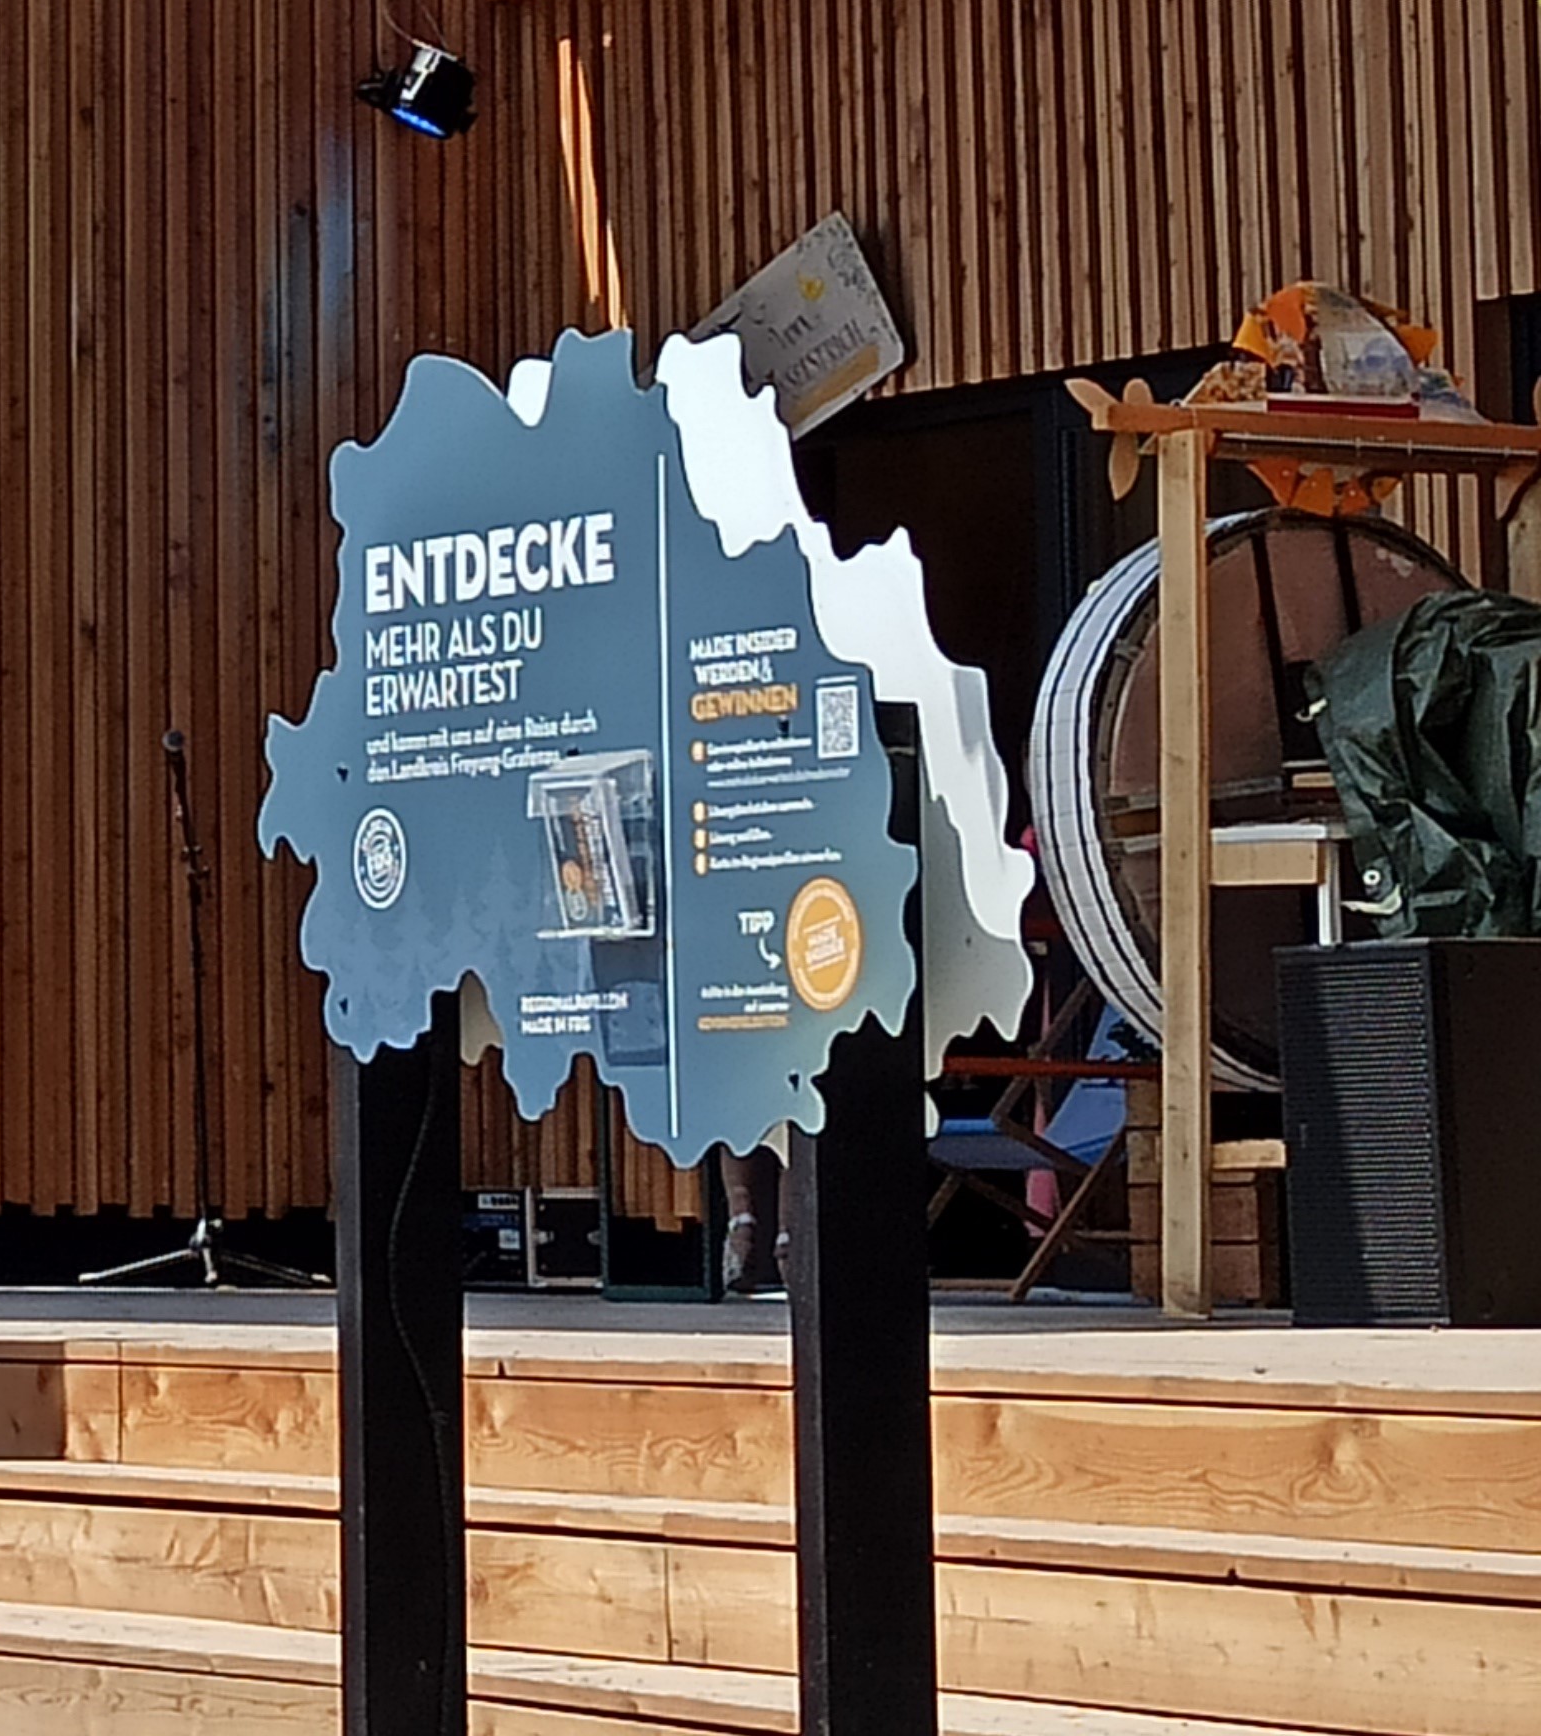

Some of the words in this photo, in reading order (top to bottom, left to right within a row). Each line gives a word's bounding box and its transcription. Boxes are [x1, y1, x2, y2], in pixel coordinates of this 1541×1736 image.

[365, 512, 615, 614] ENTDECKE
[365, 621, 441, 669] MEHR
[447, 614, 498, 660] ALS
[503, 606, 543, 653] DU
[690, 635, 734, 661] MADE
[736, 627, 798, 655] INSIDER
[366, 658, 524, 717] ERWARTEST
[693, 657, 760, 686] WERDEN
[690, 682, 799, 722] GEWINNEN
